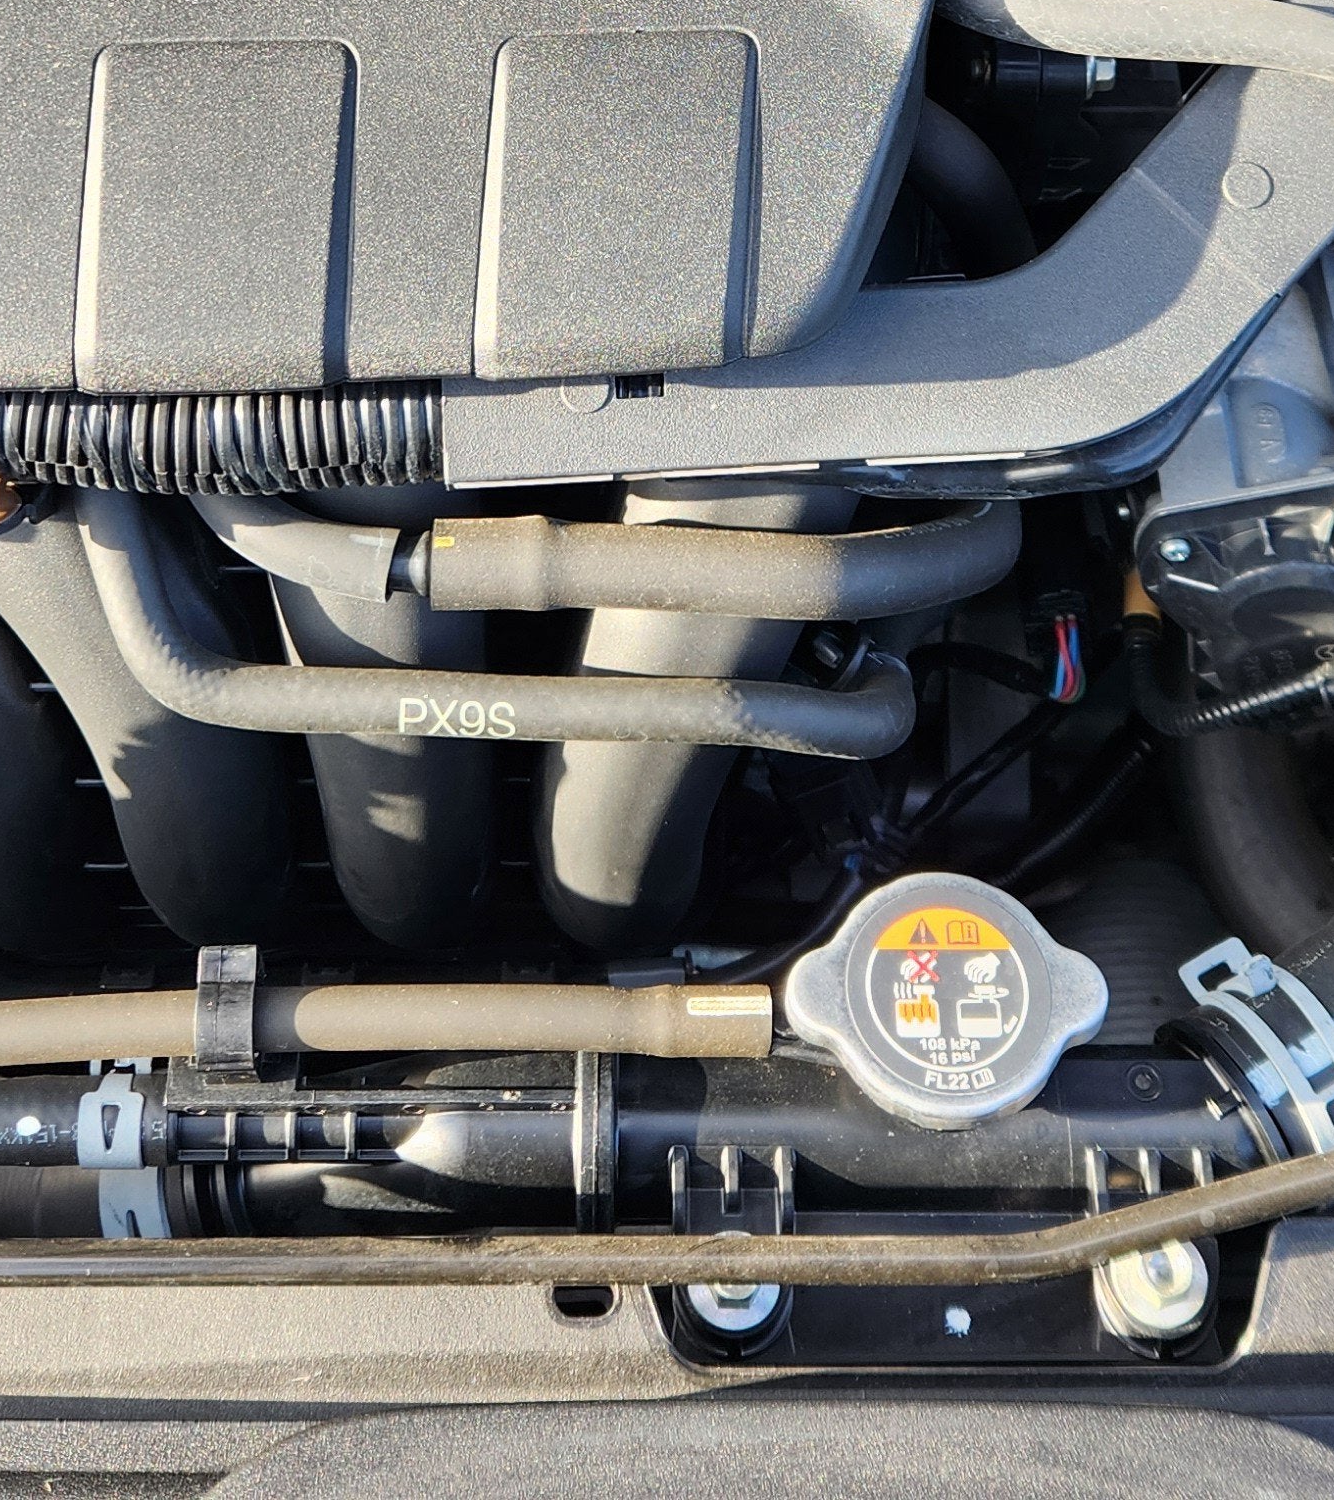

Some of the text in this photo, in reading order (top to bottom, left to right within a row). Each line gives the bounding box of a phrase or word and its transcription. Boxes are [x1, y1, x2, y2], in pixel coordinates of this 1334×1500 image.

[398, 697, 516, 738] PX9S
[919, 1037, 981, 1052] 108 kPa
[929, 1049, 978, 1066] 16 psi
[924, 1071, 971, 1090] FL22
